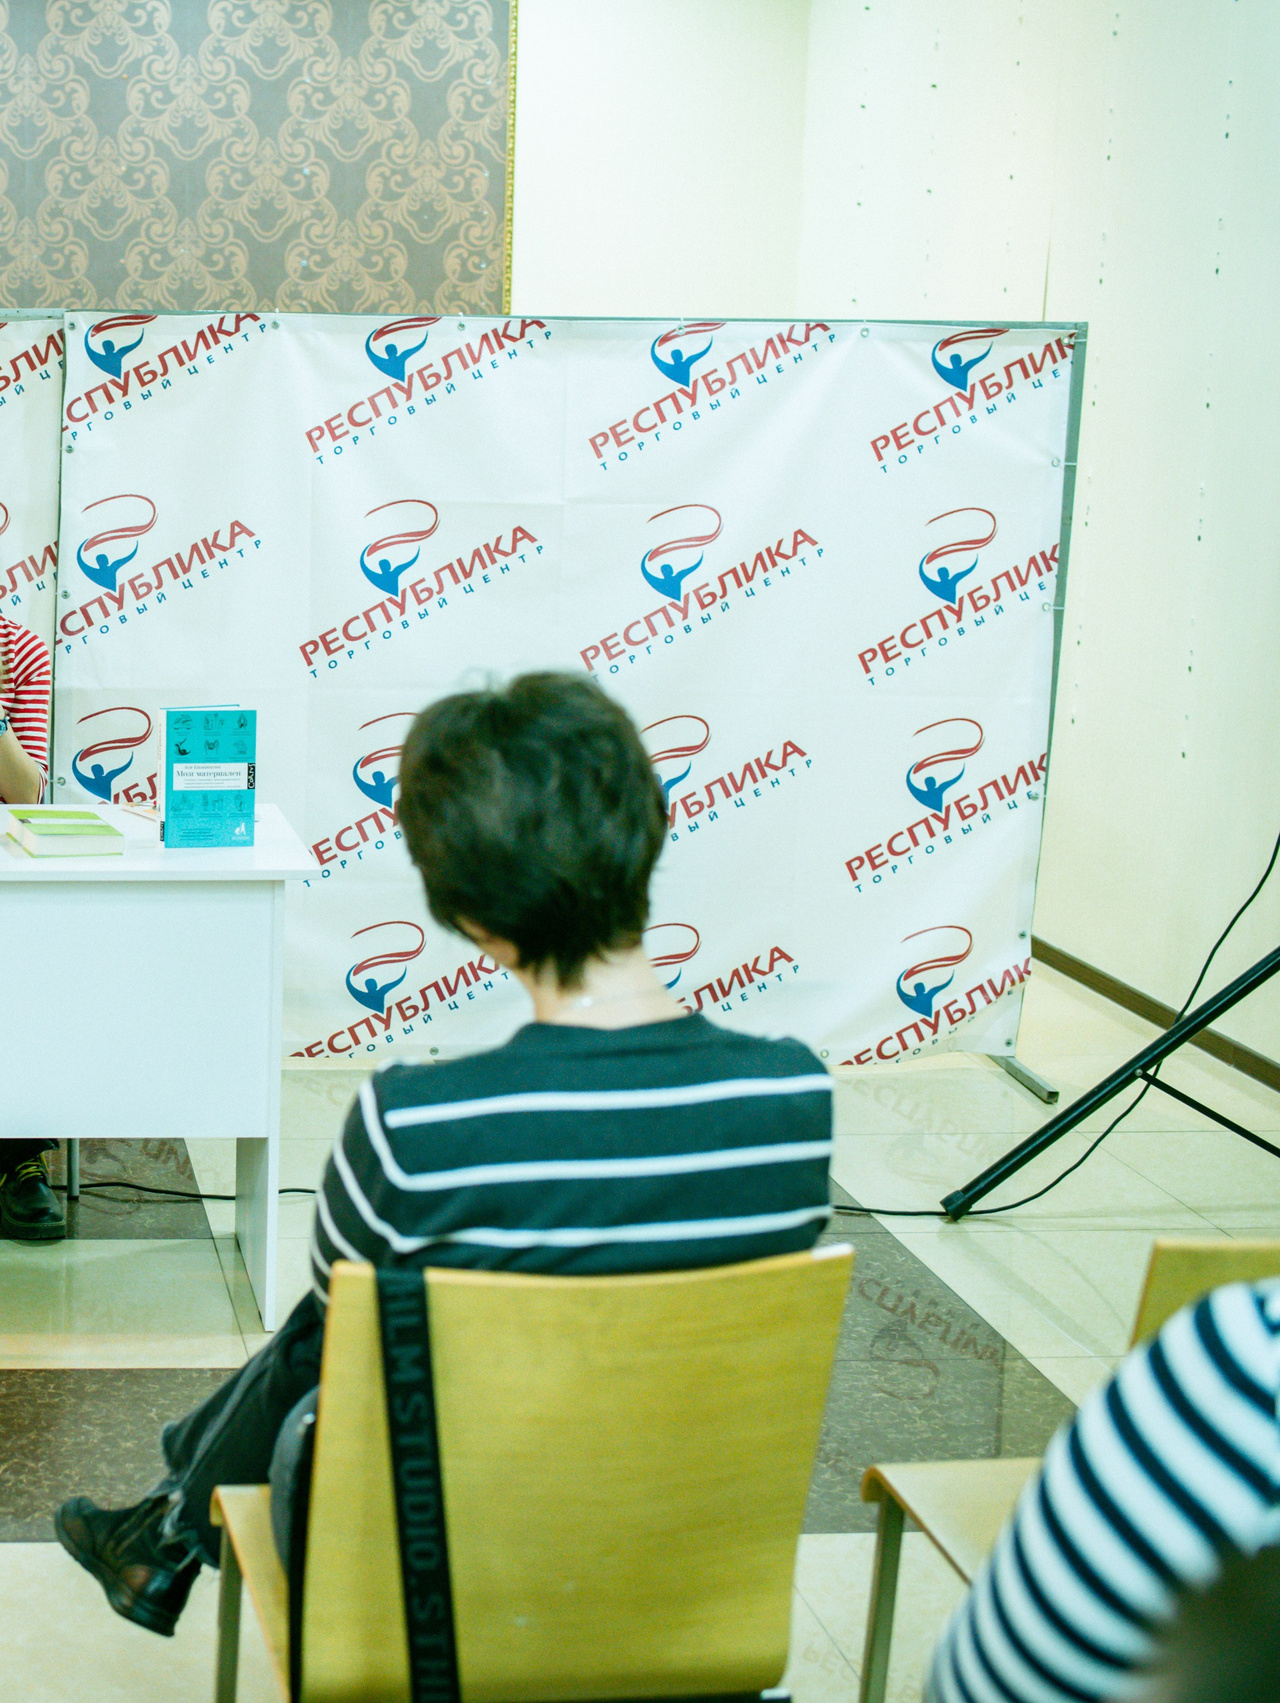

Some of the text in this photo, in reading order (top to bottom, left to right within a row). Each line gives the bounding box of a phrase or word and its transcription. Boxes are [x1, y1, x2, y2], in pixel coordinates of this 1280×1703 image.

[61, 313, 261, 433] СПУБЛИКА
[71, 323, 267, 441] РГОВЫЙ ЦЕНТР
[305, 318, 546, 453] РЕСПУБЛИКА
[316, 329, 553, 465] ТОРГОВЫЙ ЦЕНТР
[588, 321, 831, 459] РЕСПУБЛИКА
[599, 333, 836, 471] ТОРГОВЫЙ ЦЕНТР
[870, 332, 1077, 462] РЕСПУБЛИК
[880, 392, 1016, 473] ТОРГОВЫЙ
[55, 520, 256, 645] СПУБЛИКА
[65, 592, 167, 654] РГОВЫЙ
[182, 539, 262, 590] ЦЕНТР
[298, 525, 538, 667] РЕСПУБЛИКА
[310, 545, 544, 679] ТОРГОВЫЙ ЦЕНТР
[579, 528, 818, 672] РЕСПУБЛИКА
[591, 548, 824, 683] ТОРГОВЫЙ ЦЕНТР
[858, 542, 1060, 674] РЕСПУБЛИК
[868, 604, 1004, 686] ТОРГОВЫЙ
[734, 759, 812, 808] ЦЕНТР
[845, 752, 1047, 882] РЕСПУБЛИК
[303, 830, 403, 889] ТОРГОВ
[854, 813, 991, 893] ТОРГОВЫЙ
[448, 970, 509, 1011] ЦЕНТ
[721, 964, 799, 1012] ЦЕНТР
